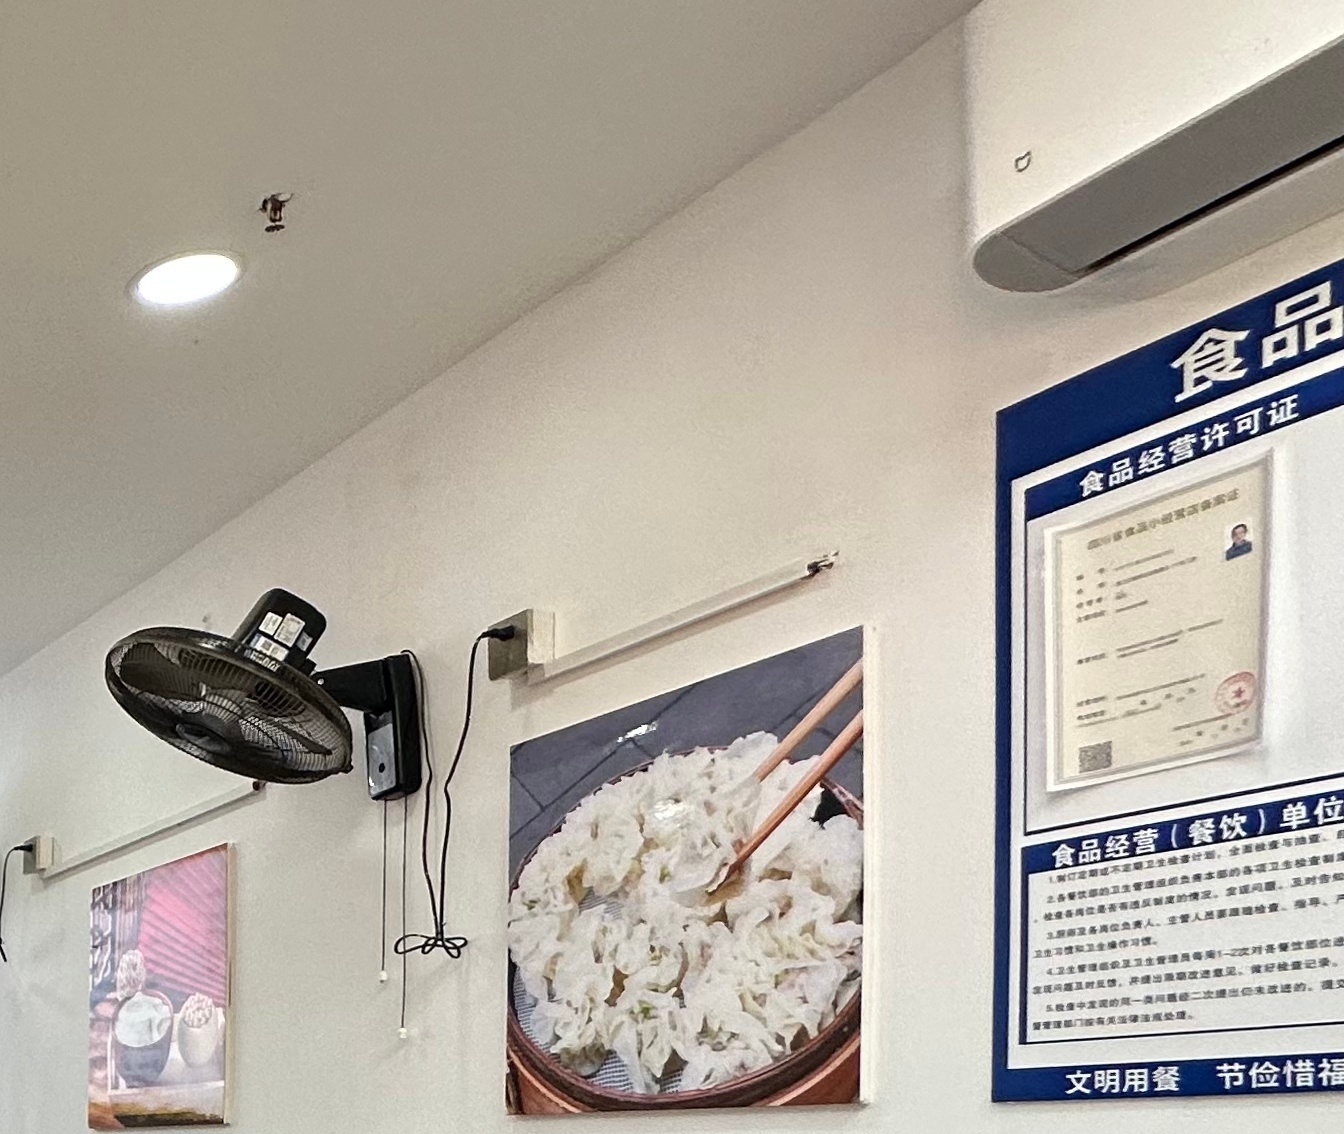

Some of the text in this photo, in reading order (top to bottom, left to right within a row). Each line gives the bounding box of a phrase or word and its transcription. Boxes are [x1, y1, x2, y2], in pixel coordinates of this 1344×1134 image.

[1171, 281, 1344, 402] 食品
[1080, 394, 1300, 497] 食品经营许可证
[1066, 1058, 1344, 1095] 文明用餐 节俭惜福
